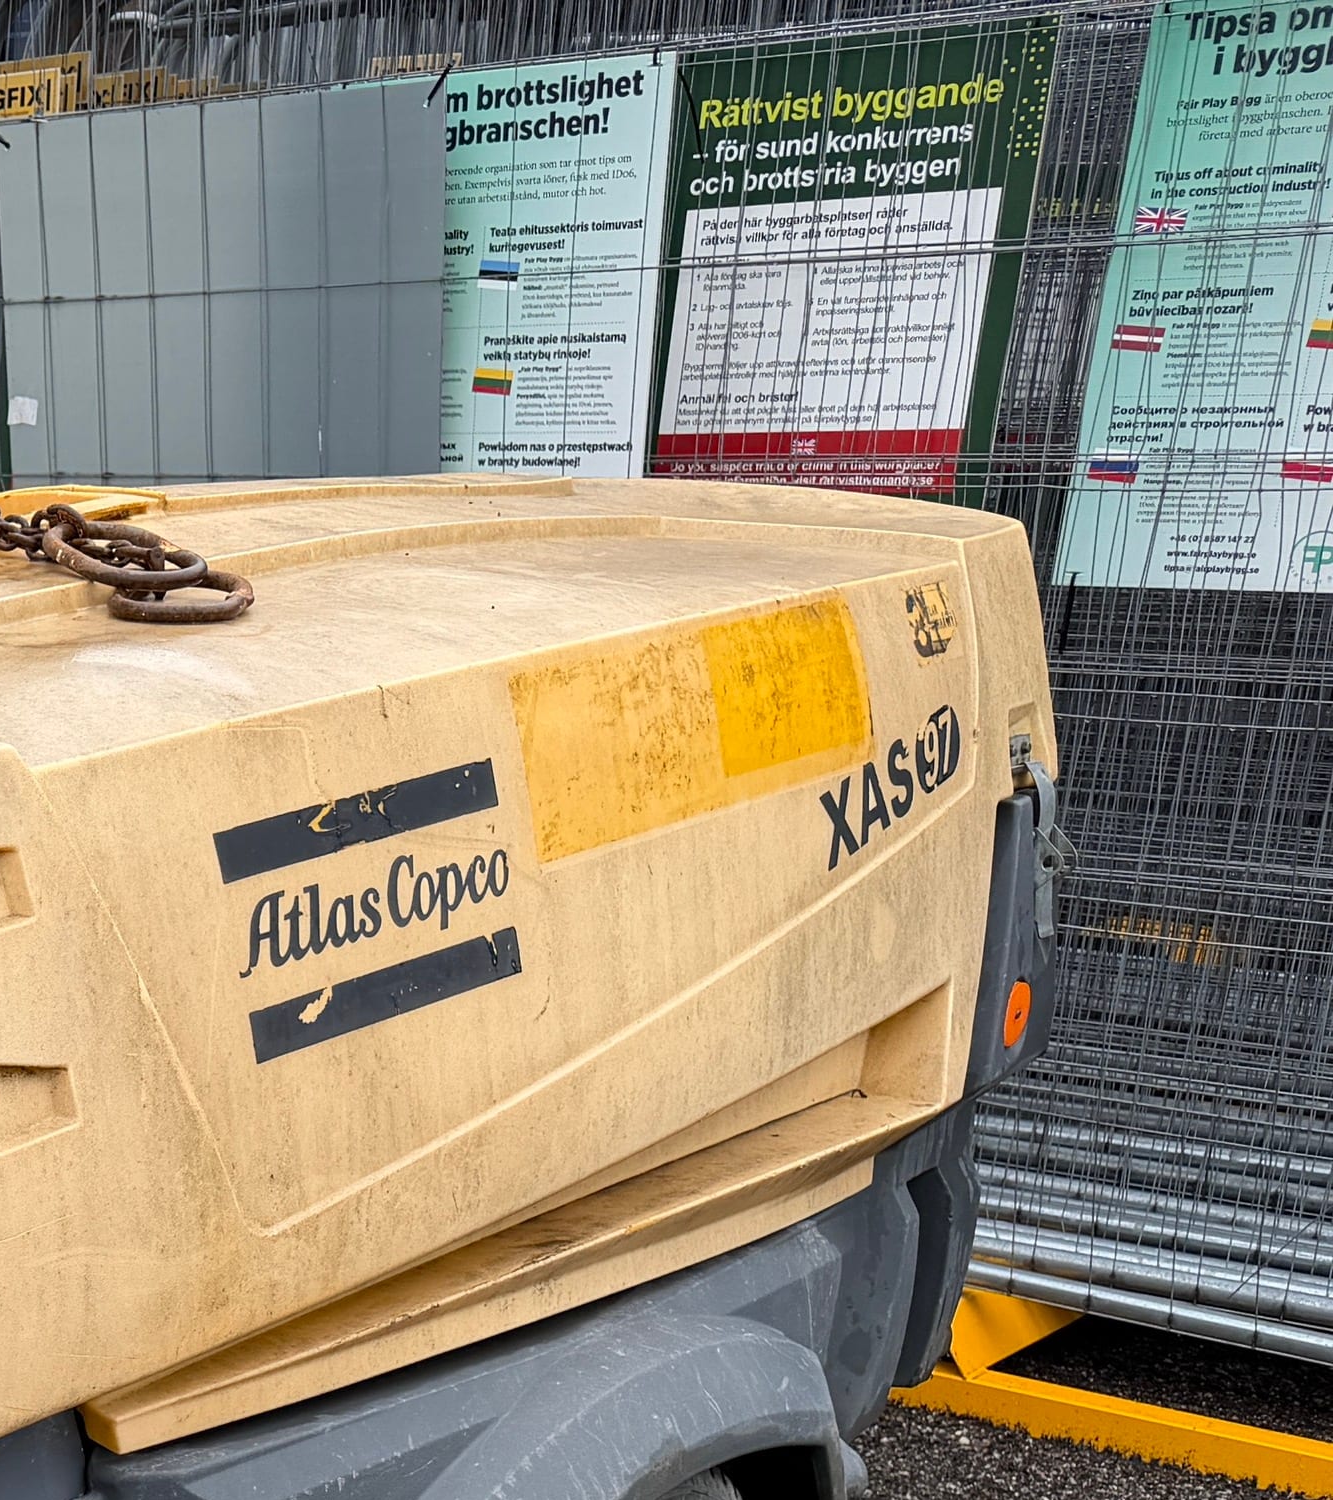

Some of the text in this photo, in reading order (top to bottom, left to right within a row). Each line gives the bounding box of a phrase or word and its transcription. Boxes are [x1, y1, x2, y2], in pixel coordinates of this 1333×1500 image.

[1185, 10, 1277, 45] Tipsa
[1213, 45, 1226, 76] i
[477, 70, 644, 111] brottslighet
[699, 72, 1005, 129] Rättvist byggande
[1176, 99, 1199, 111] Fair
[1202, 97, 1227, 110] Play
[1230, 95, 1262, 108] Bgg
[1167, 108, 1323, 128] brottslighet byggbrnschen.
[446, 107, 611, 152] gbranschen!
[1199, 124, 1313, 141] företa med arbetare
[715, 122, 974, 163] för sund konkurrens
[485, 161, 536, 176] organiation
[559, 159, 571, 168] tar
[599, 156, 615, 167] tips
[618, 155, 632, 163] om
[689, 171, 734, 196] och
[864, 155, 962, 186] byggen
[1155, 161, 1324, 184] Tip us off about cminality
[516, 176, 541, 186] svarta
[543, 174, 567, 185] löner,
[591, 171, 609, 180] med
[1150, 188, 1162, 199] in
[1189, 182, 1267, 197] consuction
[1272, 178, 1331, 192] indust!
[458, 195, 475, 205] utan
[478, 190, 540, 204] arbetstilstånd,
[543, 190, 569, 199] mutor
[589, 187, 606, 196] hot.
[744, 216, 763, 228] här
[876, 206, 908, 218] råder
[490, 218, 643, 238] Teata ehitussektoris toimuvast
[700, 234, 741, 247] rättvis
[824, 226, 865, 240] företag
[895, 220, 953, 234] anställda.
[1162, 290, 1182, 302] par
[1129, 302, 1253, 318] būviecības nozar!
[484, 332, 626, 347] Praneškite apie nusikalstamą
[513, 350, 551, 362] statybų
[680, 394, 715, 405] Anmäl
[734, 393, 755, 403] och
[1112, 406, 1176, 417] Сообщите
[478, 441, 633, 454] Powiadom nas o przestępstwach
[478, 456, 581, 469] w branży budowlanej!
[710, 462, 753, 474] suspct
[1164, 565, 1259, 574] tipsa@airplaybygg.se
[819, 707, 956, 871] XAS 97
[239, 848, 510, 979] Atlas Copco
